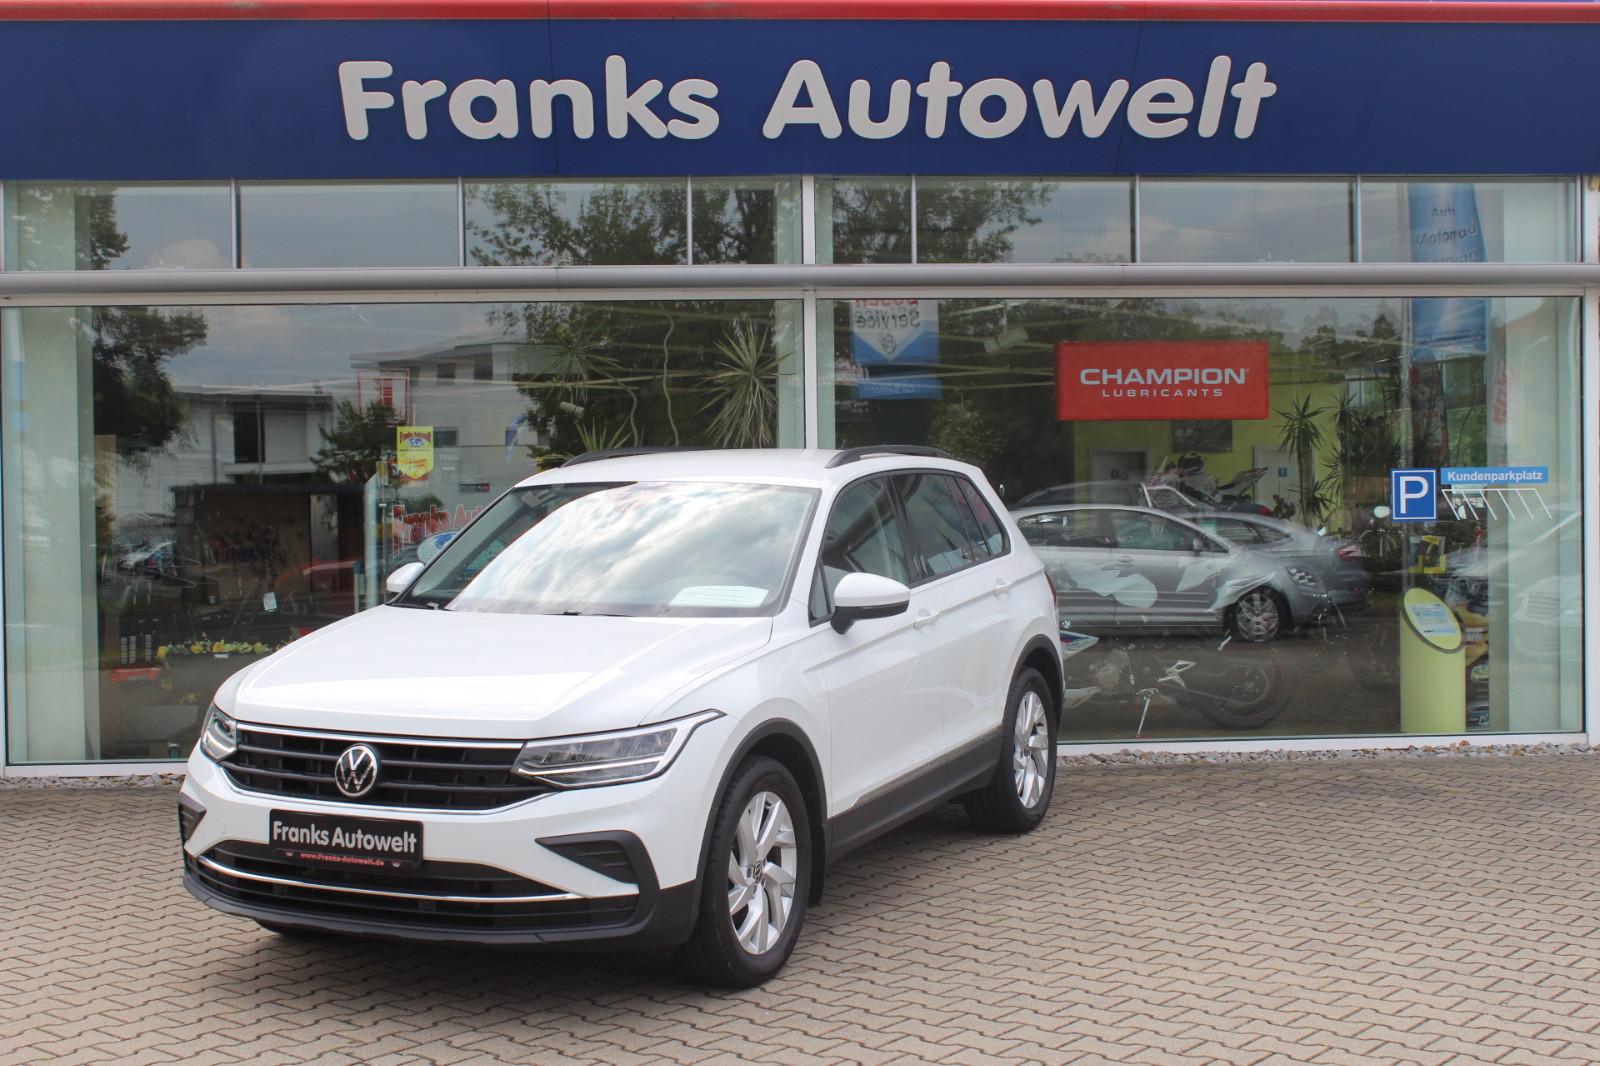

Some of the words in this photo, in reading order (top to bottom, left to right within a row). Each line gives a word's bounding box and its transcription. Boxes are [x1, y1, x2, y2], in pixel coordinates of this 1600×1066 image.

[338, 54, 720, 141] Franks
[762, 54, 1277, 140] Autowelt
[1080, 368, 1246, 385] CHAMPION
[1102, 388, 1224, 398] LUBRICANTS
[1447, 470, 1544, 483] Kundenparkplatz
[1400, 475, 1429, 514] P
[273, 820, 330, 846] Franks
[331, 826, 418, 853] Autowelt
